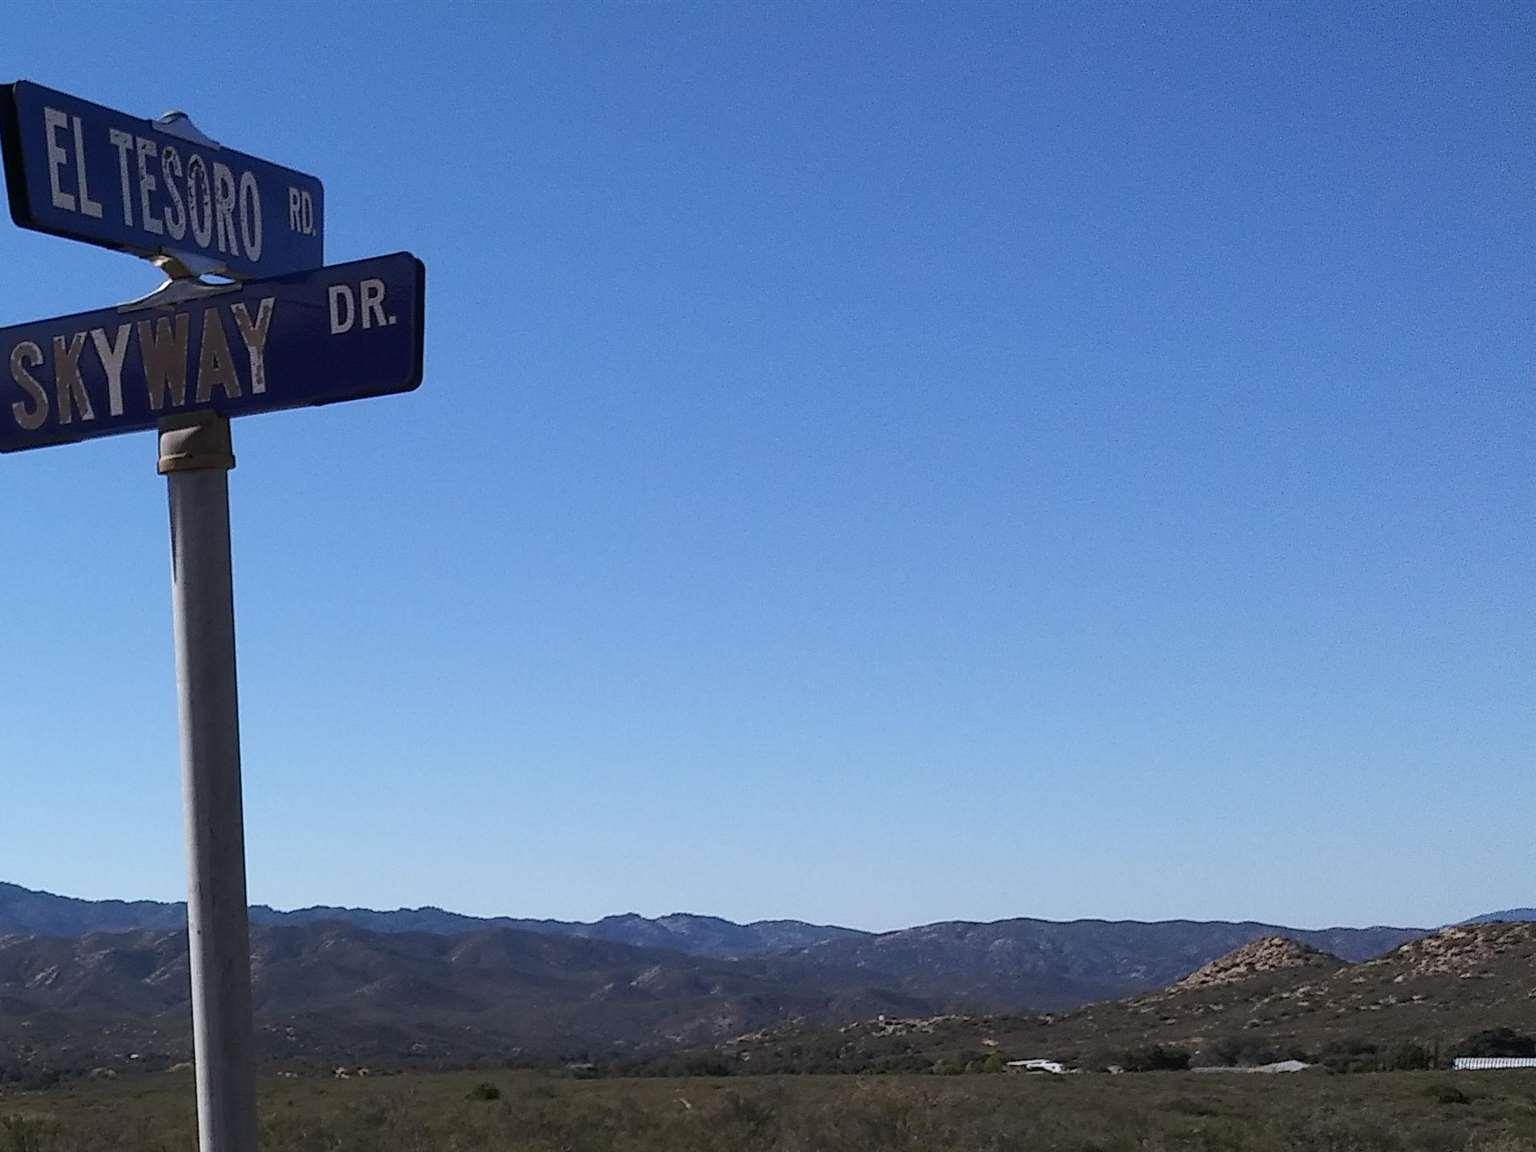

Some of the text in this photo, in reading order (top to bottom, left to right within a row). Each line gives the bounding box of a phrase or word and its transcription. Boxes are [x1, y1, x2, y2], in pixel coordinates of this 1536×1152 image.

[44, 106, 317, 262] EL TESORO RD.
[10, 278, 397, 431] SKYWAY DR.
